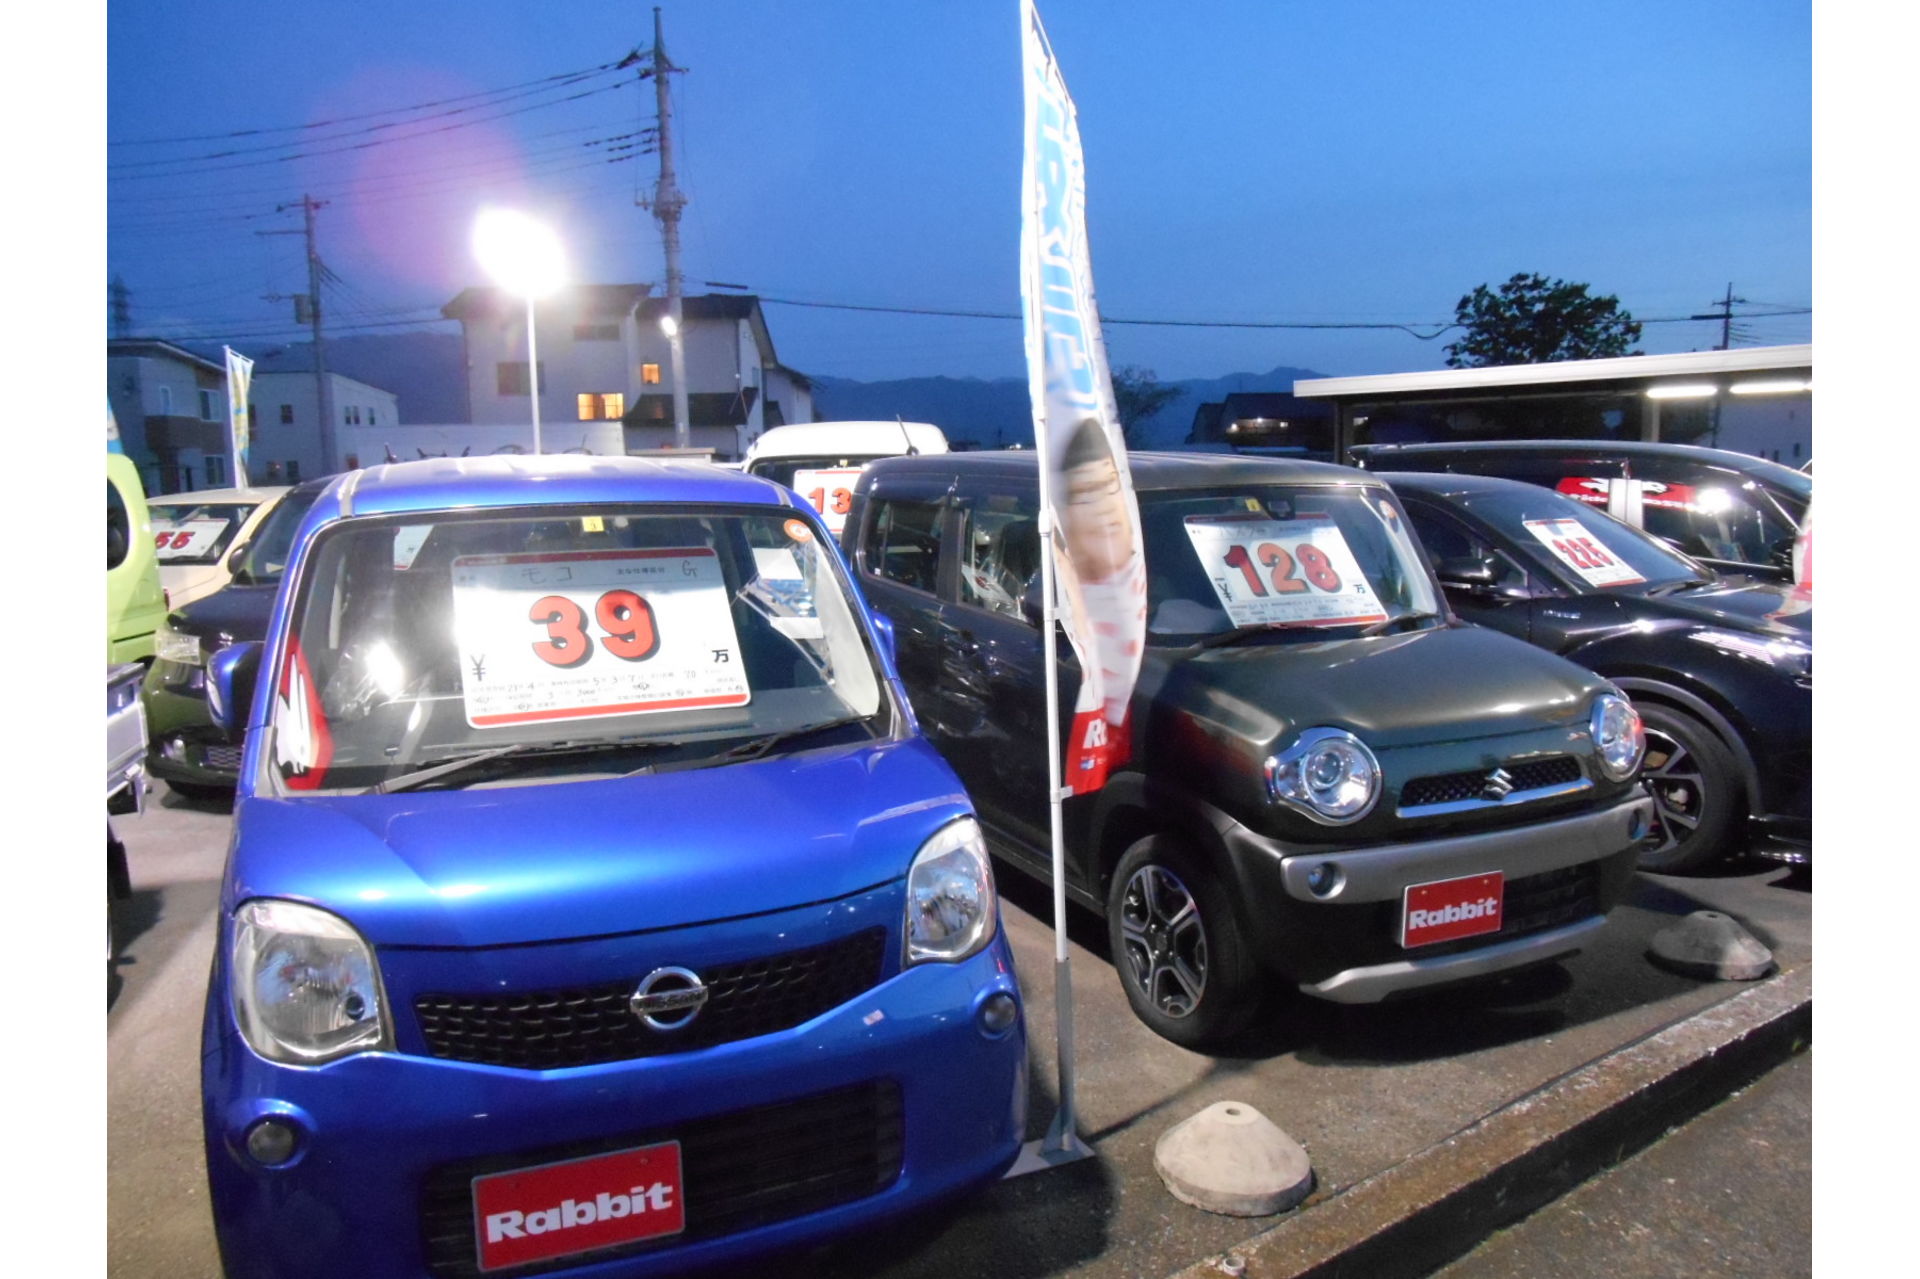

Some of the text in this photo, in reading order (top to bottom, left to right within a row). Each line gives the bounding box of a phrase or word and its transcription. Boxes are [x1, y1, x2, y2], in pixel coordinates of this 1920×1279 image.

[1223, 543, 1342, 597] 128
[529, 588, 661, 669] 39
[470, 654, 486, 681] ¥
[711, 648, 730, 663] 万
[1408, 896, 1497, 930] Rabbit
[486, 1182, 673, 1244] Rabbit
